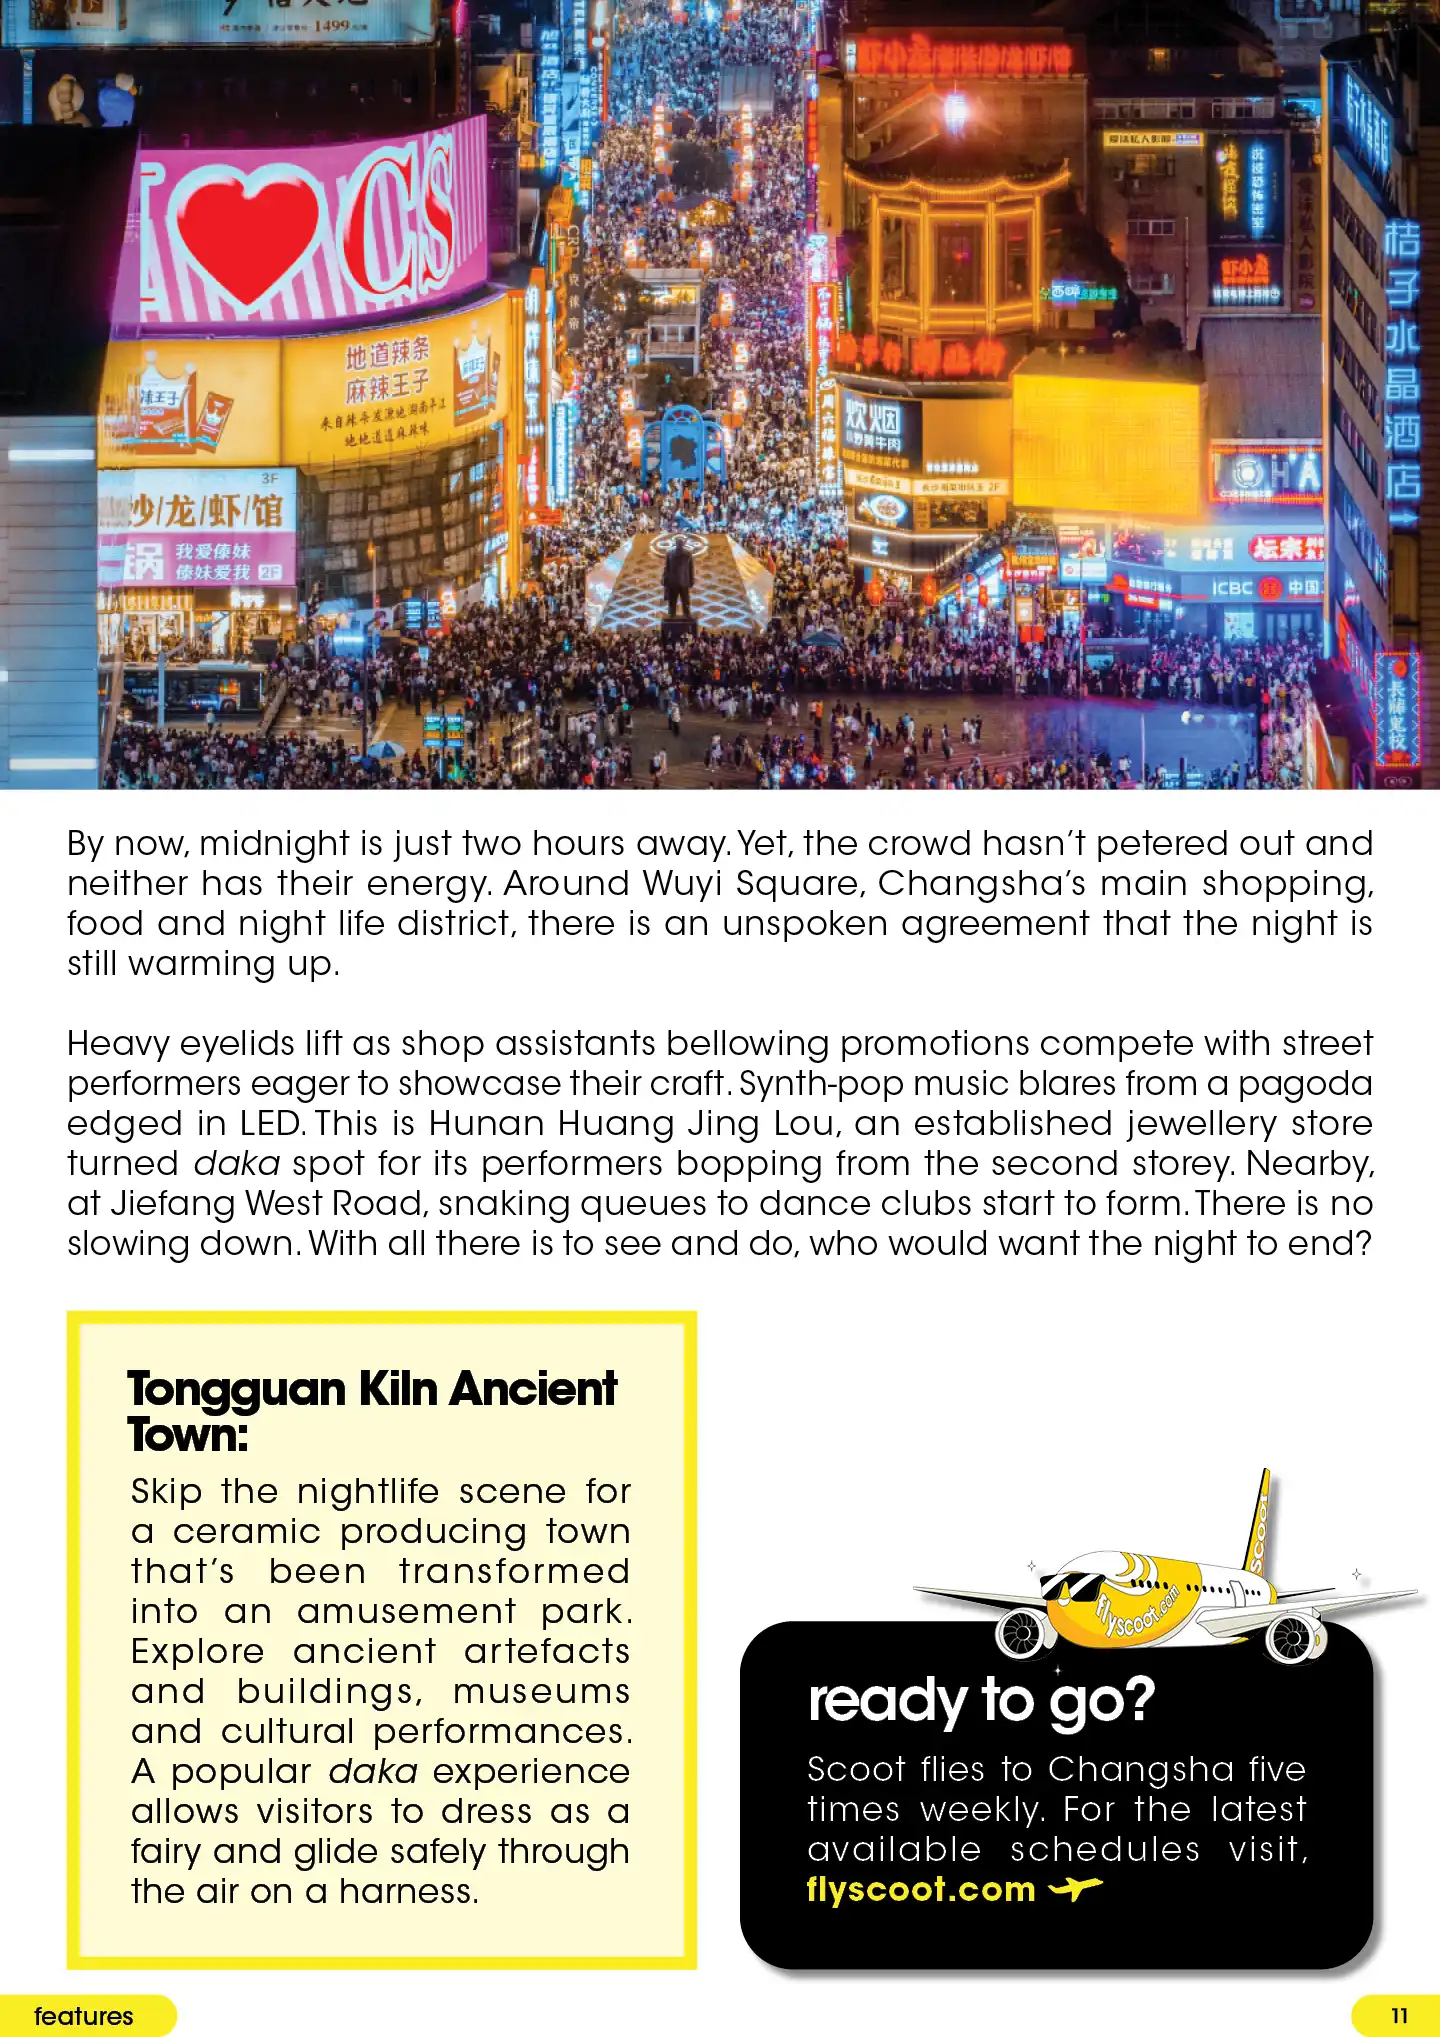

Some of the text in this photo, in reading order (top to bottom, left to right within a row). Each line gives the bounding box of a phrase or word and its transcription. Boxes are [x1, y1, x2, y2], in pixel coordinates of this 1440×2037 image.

[315, 20, 349, 32] 1499
[337, 135, 456, 303] CS
[345, 335, 431, 372] 地道辣条
[1384, 219, 1421, 500] 桔子水晶酒店
[345, 368, 431, 405] 麻辣王子
[846, 398, 900, 434] 炊烟
[261, 472, 280, 485] 3F
[988, 483, 1000, 492] 2F
[261, 566, 281, 579] 2F
[1213, 581, 1253, 595] ICBC
[1288, 580, 1324, 596] 中国
[68, 829, 105, 863] By
[115, 835, 190, 858] now,
[200, 829, 351, 864] midnight
[361, 829, 383, 856] is
[393, 829, 453, 863] just
[461, 829, 522, 856] two
[533, 829, 625, 856] hours
[636, 835, 731, 863] away.
[737, 829, 794, 858] Yet,
[802, 829, 858, 856] the
[868, 829, 971, 856] crowd
[1097, 829, 1228, 863] petered
[1239, 829, 1296, 856] out
[1305, 829, 1373, 856] and
[68, 949, 339, 984] still warming up.
[68, 1029, 1375, 1064] Heavy eyelids lift as shop assistants bellowing promotions compete with street
[67, 1109, 1373, 1144] edged in LED. This is Hunan Huang Jing Lou, an established jewellery store
[126, 1369, 619, 1416] Tongguan Kiln Ancient
[126, 1414, 252, 1452] Town:
[131, 1477, 632, 1512] Skip the nightlife scene for
[131, 1517, 630, 1552] a ceramic producing town
[270, 1557, 365, 1584] been
[398, 1557, 629, 1584] transformed
[132, 1597, 632, 1631] into an amusement park.
[1095, 1585, 1180, 1638] flyscoot.com
[132, 1637, 630, 1671] Explore ancient artefacts
[131, 1677, 630, 1712] and buildings, museums
[810, 1674, 1156, 1736] ready to go?
[131, 1717, 632, 1751] and cultural performances.
[130, 1757, 630, 1791] A popular daka experience
[808, 1755, 1306, 1790] Scoot flies to Changsha five
[131, 1797, 629, 1824] allows visitors to dress as a
[807, 1795, 1307, 1829] times weekly. For the latest
[130, 1837, 629, 1872] fairy and glide safely through
[808, 1835, 1308, 1864] available schedules visit,
[130, 1877, 478, 1904] the air on a harness.
[806, 1875, 1035, 1909] flyscoot.com
[33, 2006, 134, 2026] features
[1391, 2007, 1407, 2024] 11
